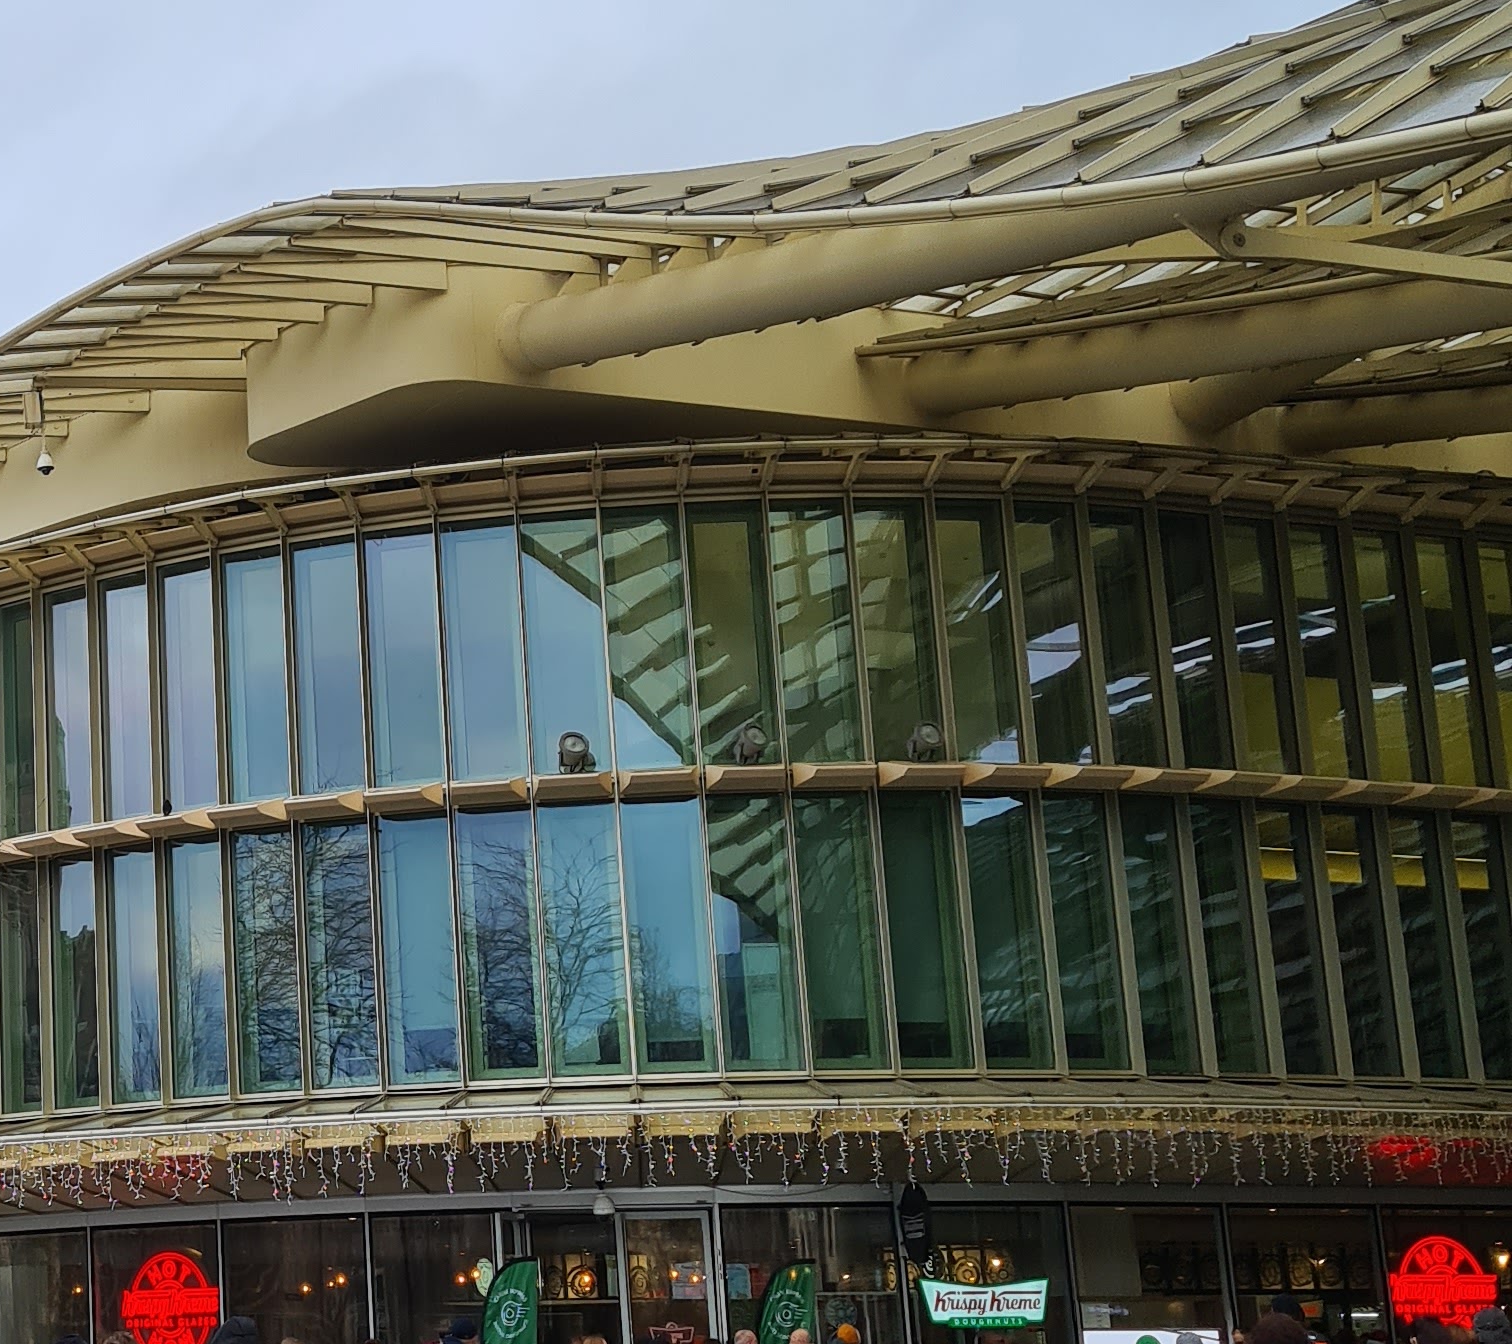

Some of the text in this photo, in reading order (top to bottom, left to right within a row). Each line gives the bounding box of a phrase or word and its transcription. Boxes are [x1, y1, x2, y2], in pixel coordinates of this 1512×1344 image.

[1415, 1244, 1465, 1270] HOT
[147, 1259, 191, 1286] HOT
[934, 1290, 1042, 1315] Krispy Kreme
[1395, 1304, 1451, 1314] ORIGINAL
[126, 1316, 218, 1328] ORIGINAL GLAZED
[953, 1317, 1023, 1326] DOUGHNUTS
